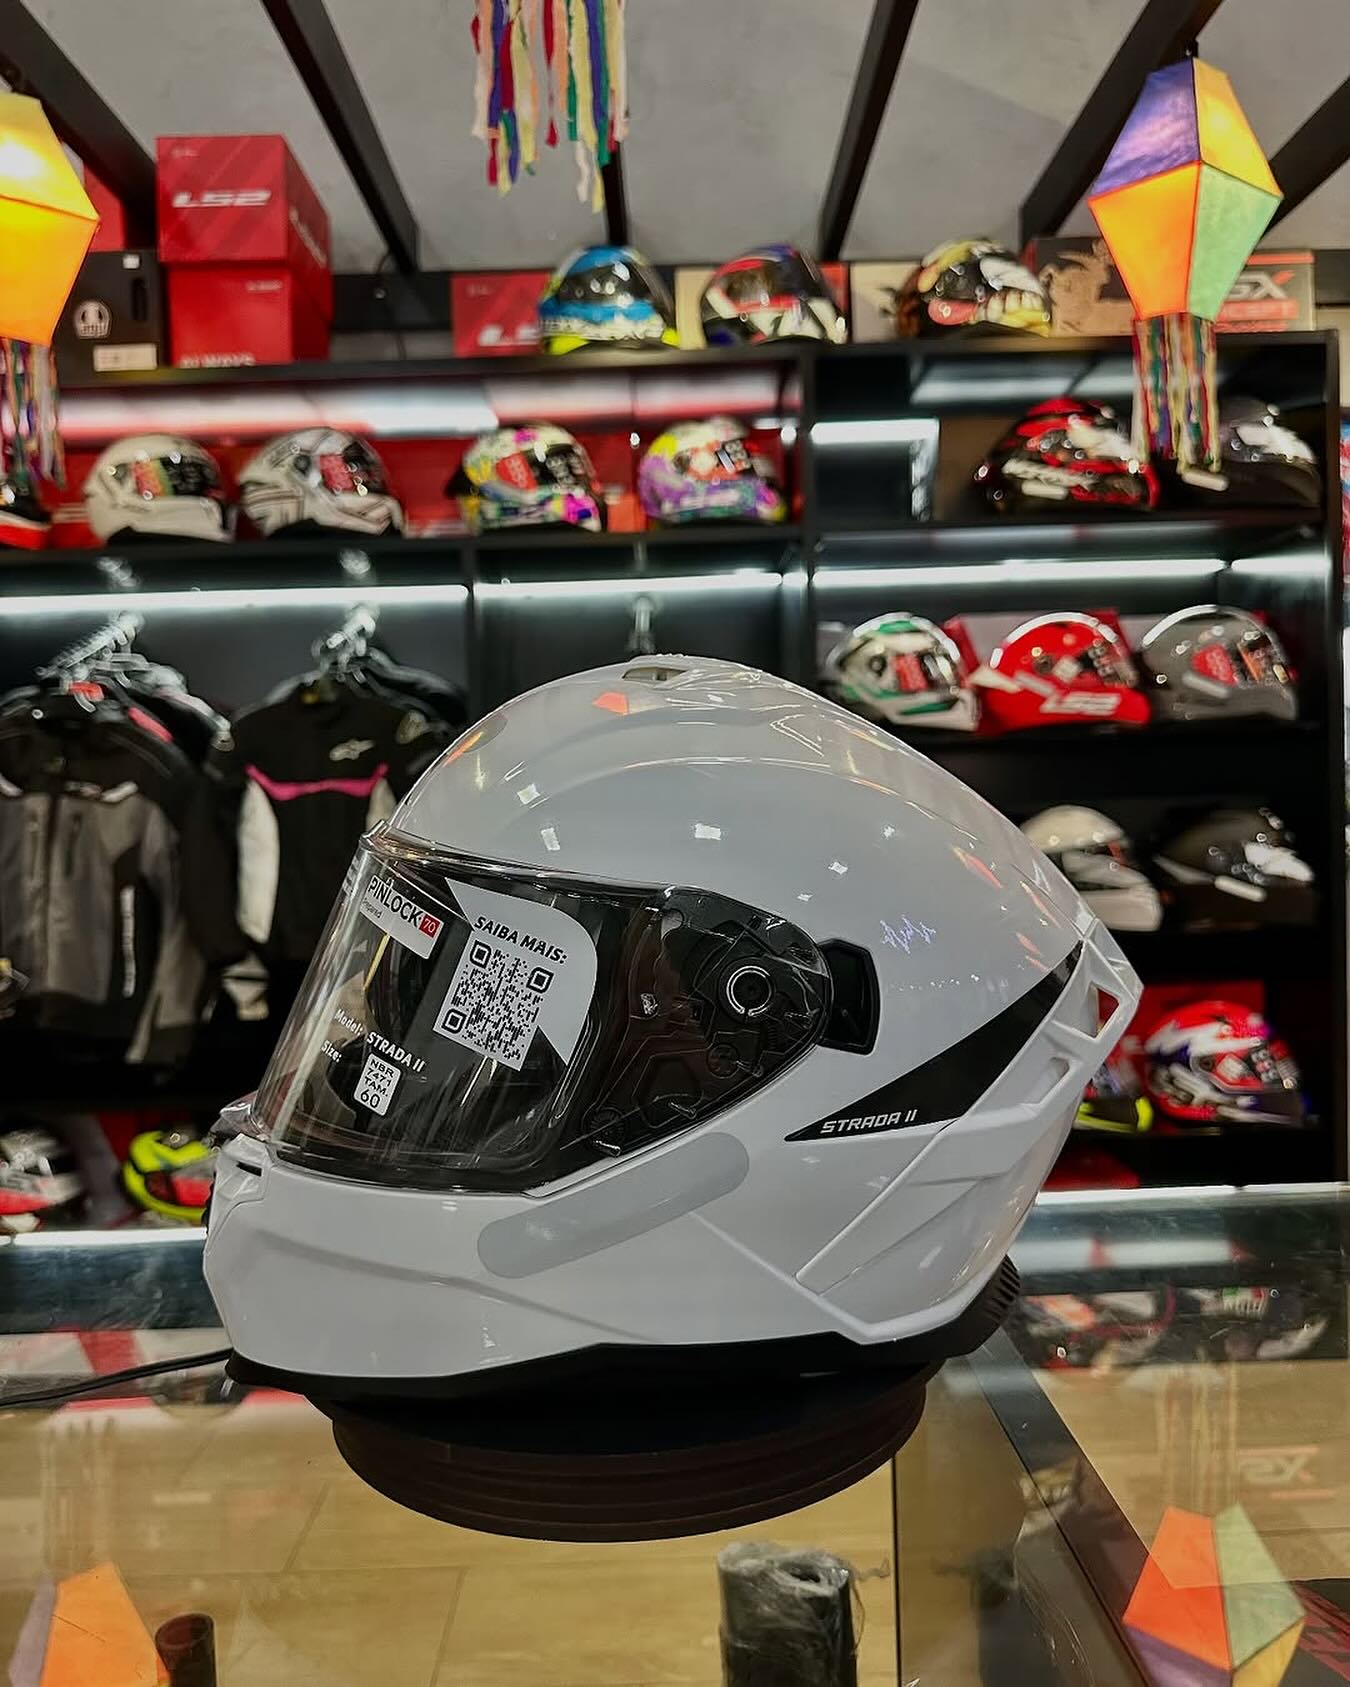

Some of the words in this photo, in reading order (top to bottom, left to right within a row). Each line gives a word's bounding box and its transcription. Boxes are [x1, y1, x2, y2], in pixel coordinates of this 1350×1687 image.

[173, 190, 272, 208] LS2
[367, 877, 424, 928] PINLOCK
[423, 918, 437, 933] 70
[474, 916, 519, 944] SAIBA
[519, 935, 568, 964] MAIS:
[334, 1009, 364, 1037] Model:
[321, 1040, 343, 1063] Size:
[366, 1031, 413, 1067] STRADA
[412, 1058, 427, 1073] II
[367, 1068, 393, 1087] 7471
[370, 1059, 395, 1078] NBR
[364, 1076, 389, 1097] TAM.
[360, 1089, 381, 1109] 60
[820, 1112, 902, 1134] STRADA
[904, 1109, 918, 1123] II
